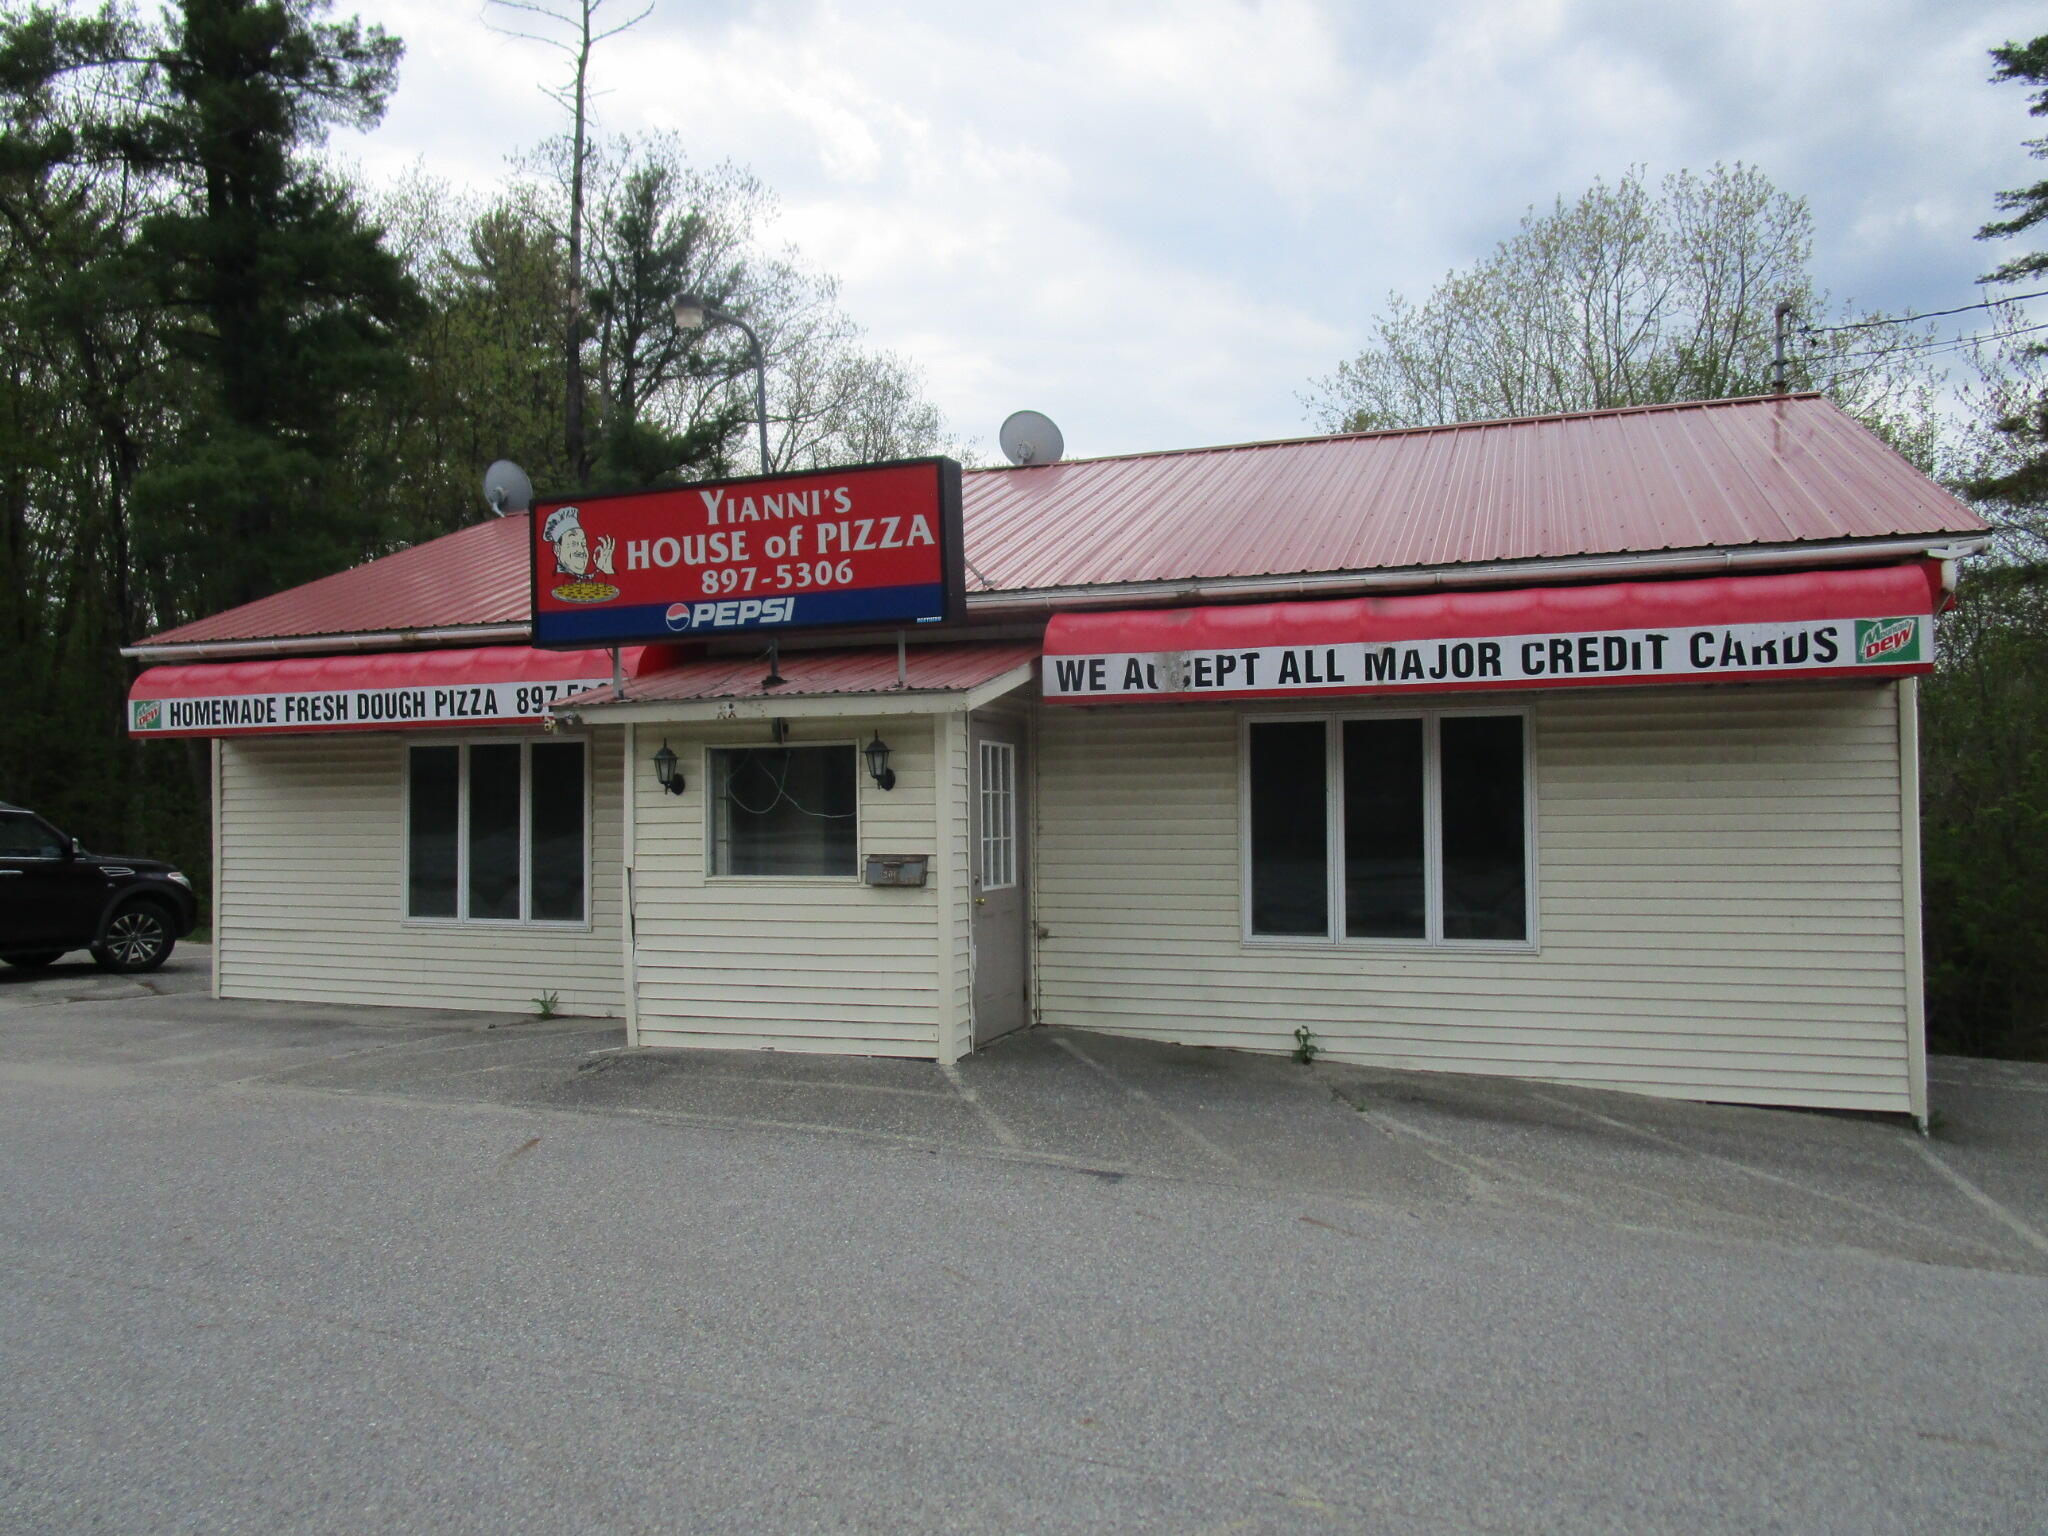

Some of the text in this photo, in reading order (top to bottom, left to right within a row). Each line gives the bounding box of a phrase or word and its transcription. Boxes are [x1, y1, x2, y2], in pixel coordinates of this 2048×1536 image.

[700, 487, 852, 526] YIANNI'S
[627, 514, 936, 571] HOUSE of PIZZA
[701, 558, 854, 595] 897-5306
[691, 596, 795, 629] PEPSI
[1055, 658, 1107, 692] WE
[1277, 648, 1346, 685] ALL
[1365, 641, 1502, 682] MAJOR
[1521, 633, 1670, 676] CREDIT
[169, 696, 277, 728] HOMEMADE
[285, 694, 349, 723] FRESH
[357, 690, 427, 722] DOUGH
[434, 687, 500, 718] PIZZA
